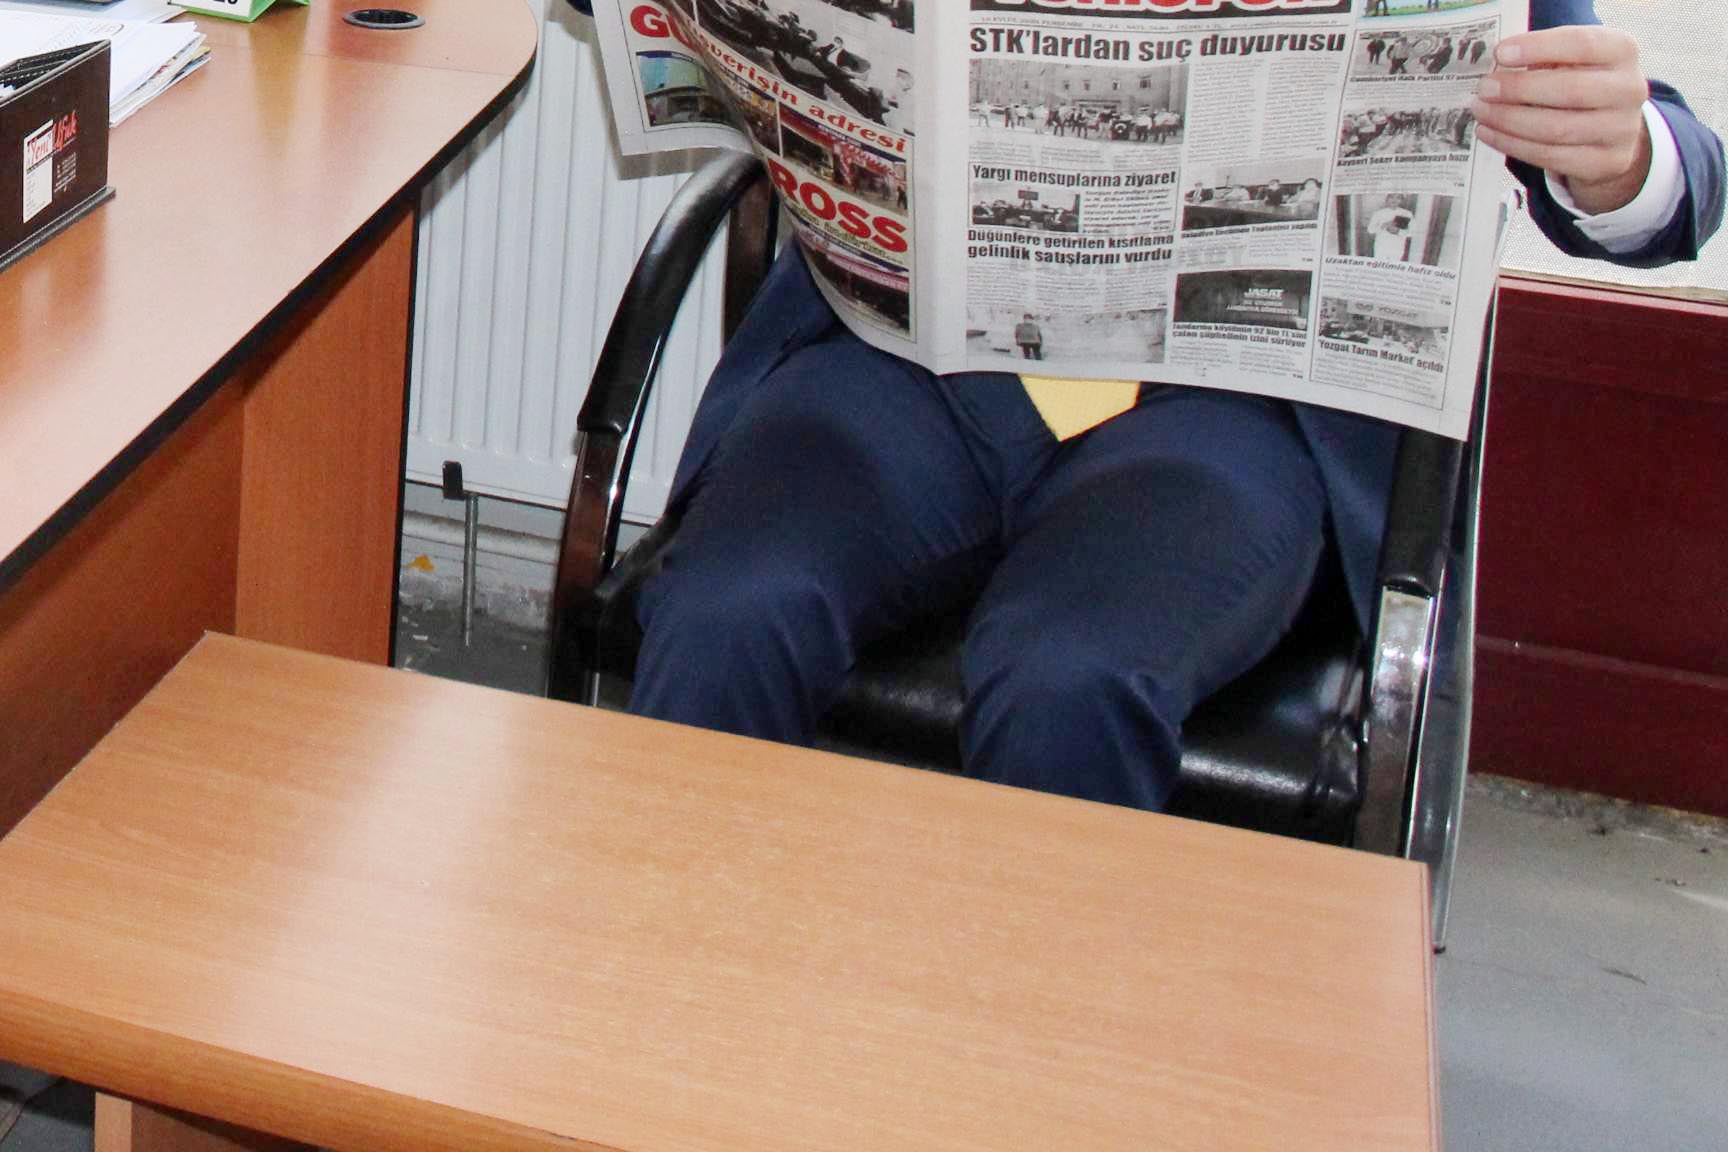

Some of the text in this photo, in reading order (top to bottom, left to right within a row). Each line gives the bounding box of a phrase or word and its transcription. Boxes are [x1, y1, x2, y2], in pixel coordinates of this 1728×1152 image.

[969, 26, 1347, 63] STK'lardan suç duyurusu
[808, 104, 908, 154] adresi
[972, 164, 1177, 188] Yargı mensuplarına ziyaret
[967, 229, 1174, 250] Düğünlere getirilen kısıtlama
[967, 244, 1173, 265] gelinlik satışlarını vurdu
[1325, 256, 1457, 280] Uzaktan eğitimle hafız oldu
[1352, 344, 1378, 358] Tarım
[1416, 358, 1444, 374] açıldı
